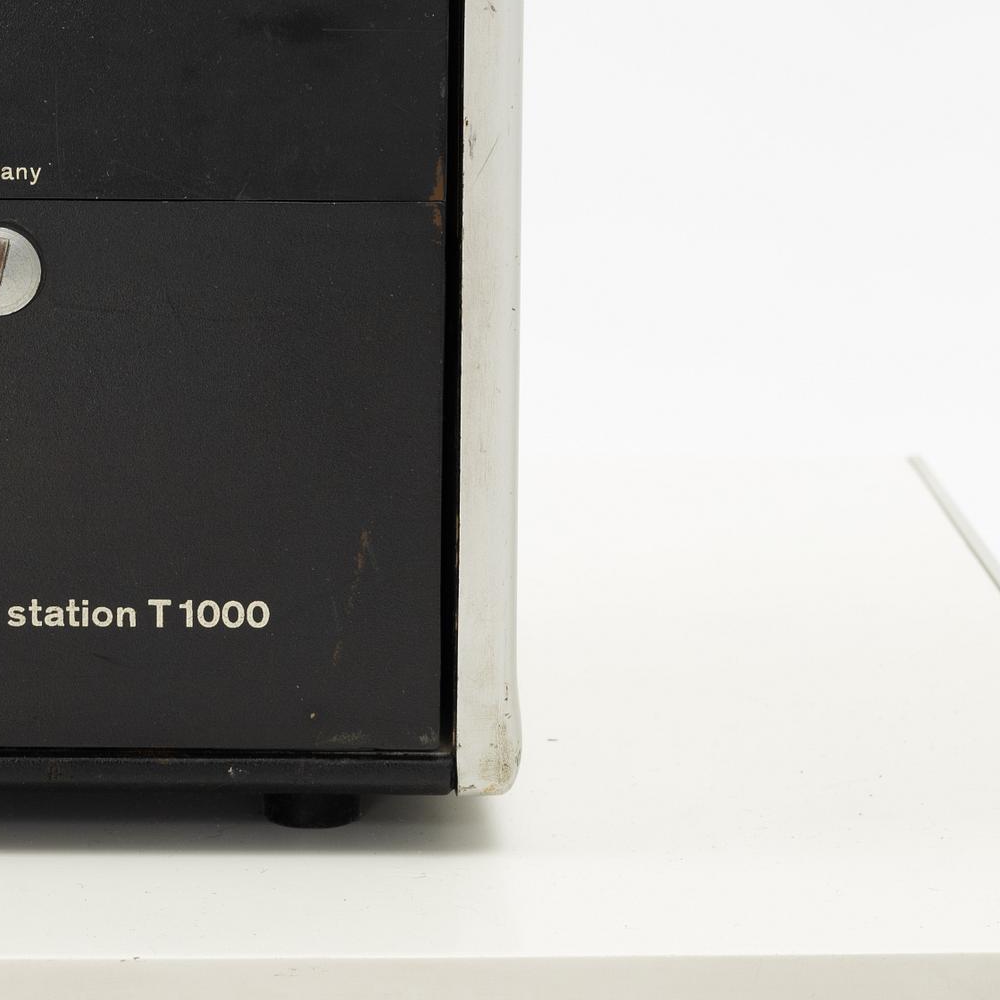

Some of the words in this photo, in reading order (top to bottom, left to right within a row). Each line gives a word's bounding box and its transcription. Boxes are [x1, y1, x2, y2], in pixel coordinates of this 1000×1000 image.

[7, 598, 137, 628] station
[147, 598, 172, 629] T
[178, 599, 271, 629] 1000
